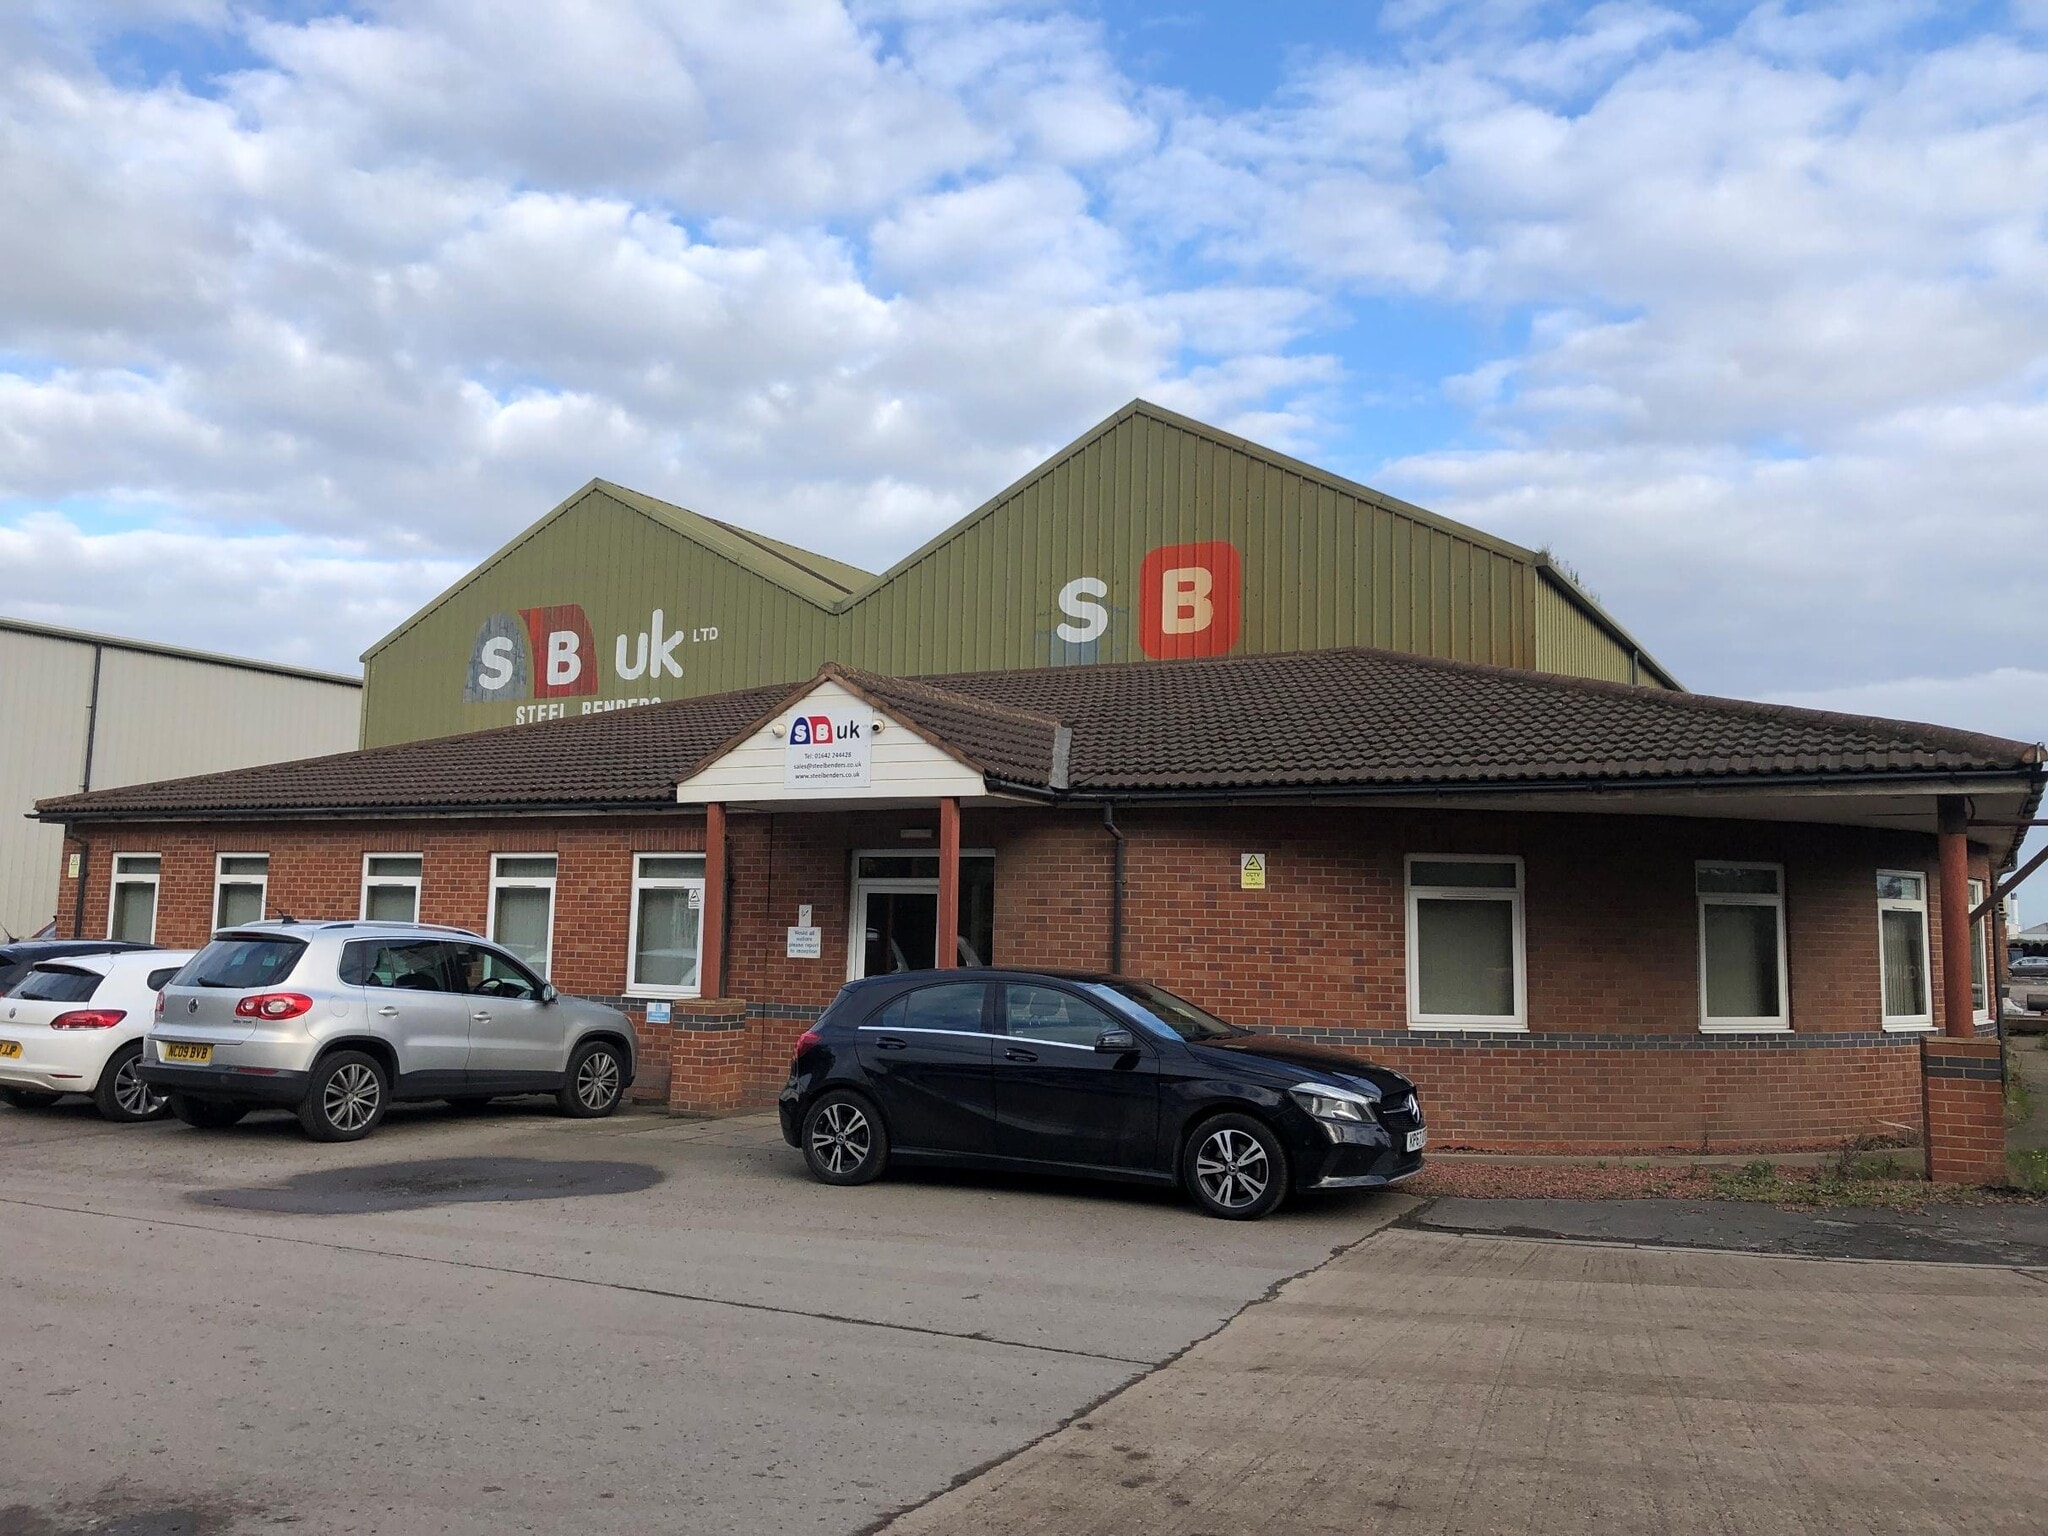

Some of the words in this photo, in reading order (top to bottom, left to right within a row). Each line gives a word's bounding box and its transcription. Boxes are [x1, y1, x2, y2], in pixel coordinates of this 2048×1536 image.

[1056, 577, 1108, 644] S
[1162, 567, 1214, 634] B
[478, 636, 514, 690] S
[546, 631, 581, 686] B
[693, 627, 718, 643] LTD
[794, 725, 807, 742] S
[815, 724, 829, 741] B
[837, 720, 860, 739] uk
[793, 761, 862, 770] sales@steelbenders.co.uk
[795, 771, 860, 779] www.steelbenders.co.uk
[168, 1044, 189, 1058] NC09
[189, 1046, 208, 1059] BVB
